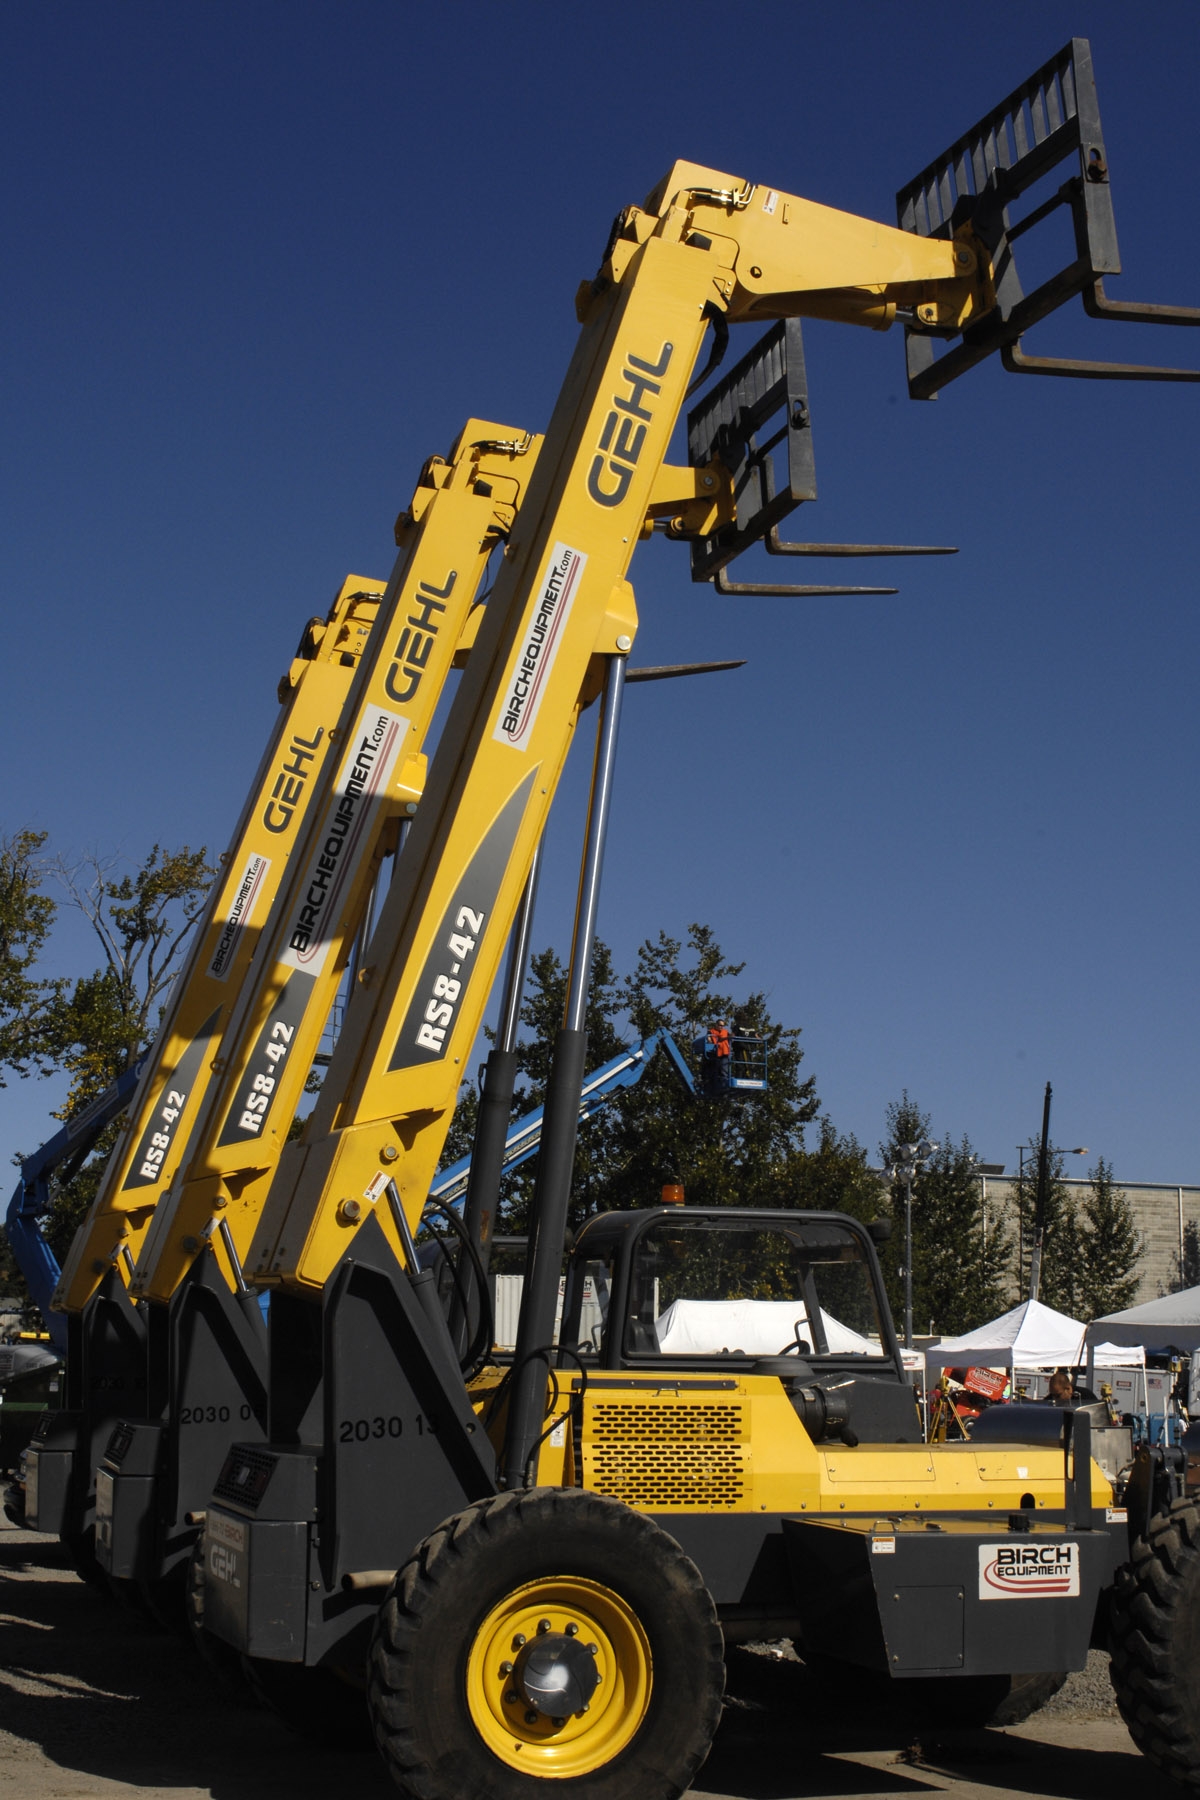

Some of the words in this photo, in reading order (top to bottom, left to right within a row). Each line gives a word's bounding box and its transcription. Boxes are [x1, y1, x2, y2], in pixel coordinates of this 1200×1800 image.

[588, 342, 673, 507] GEHL
[385, 570, 458, 703] GEHL
[501, 549, 573, 735] BIRCHEQUIPMENT.com
[264, 726, 325, 833] GEHL
[290, 715, 389, 953] BIRCHEQUIPMENT.com
[212, 857, 262, 976] BIRCHEQUIPMENT.com
[415, 905, 485, 1053] RS8-42
[238, 1021, 295, 1132] RS8-42
[139, 1090, 186, 1180] RS8-42
[181, 1406, 230, 1425] 2030
[340, 1416, 403, 1443] 2030
[210, 1544, 241, 1588] GEHL
[997, 1547, 1071, 1565] BIRCH
[997, 1565, 1071, 1576] EQUIPMENT
